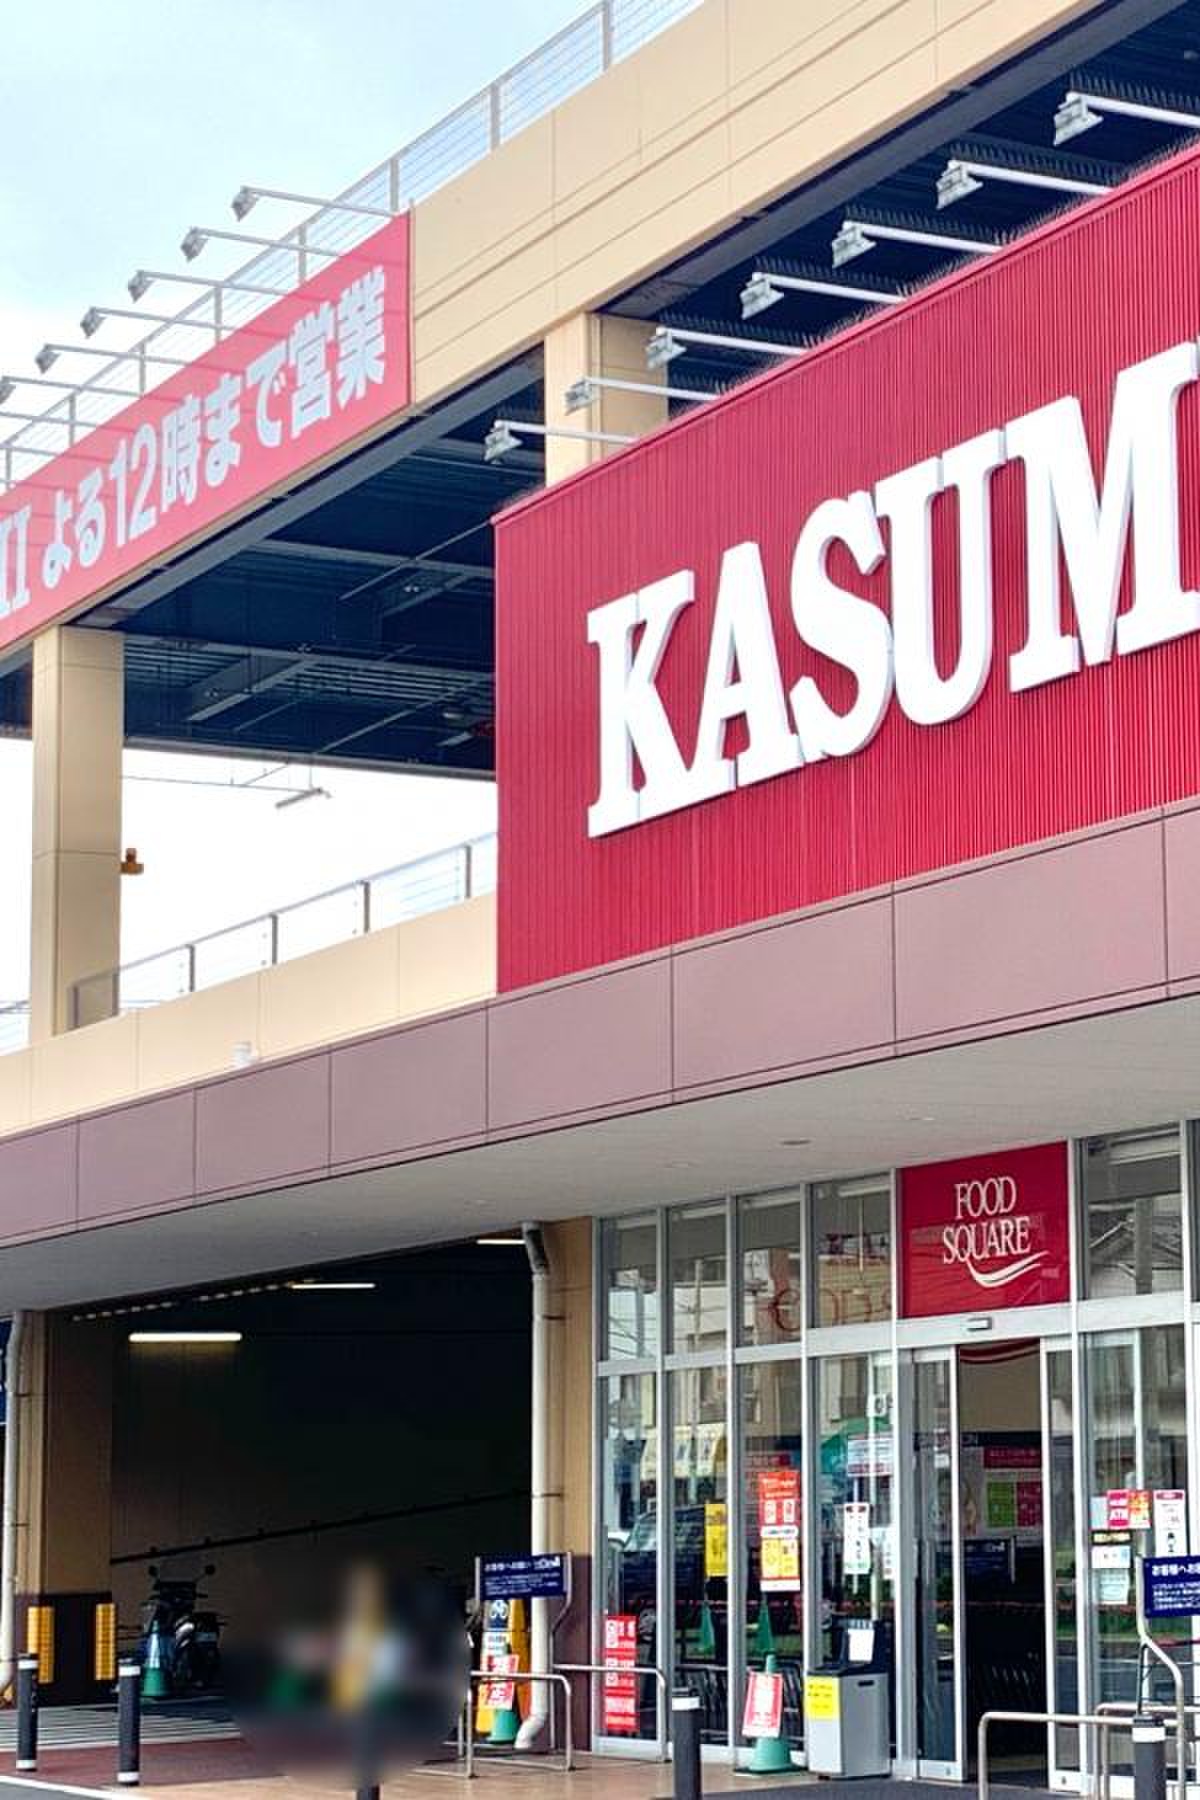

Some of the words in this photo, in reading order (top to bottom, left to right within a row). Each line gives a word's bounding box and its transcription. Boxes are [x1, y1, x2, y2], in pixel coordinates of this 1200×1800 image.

[42, 265, 386, 590] よる12時まで営業
[953, 1175, 1017, 1220] FOOD
[943, 1215, 1032, 1265] SQUARE
